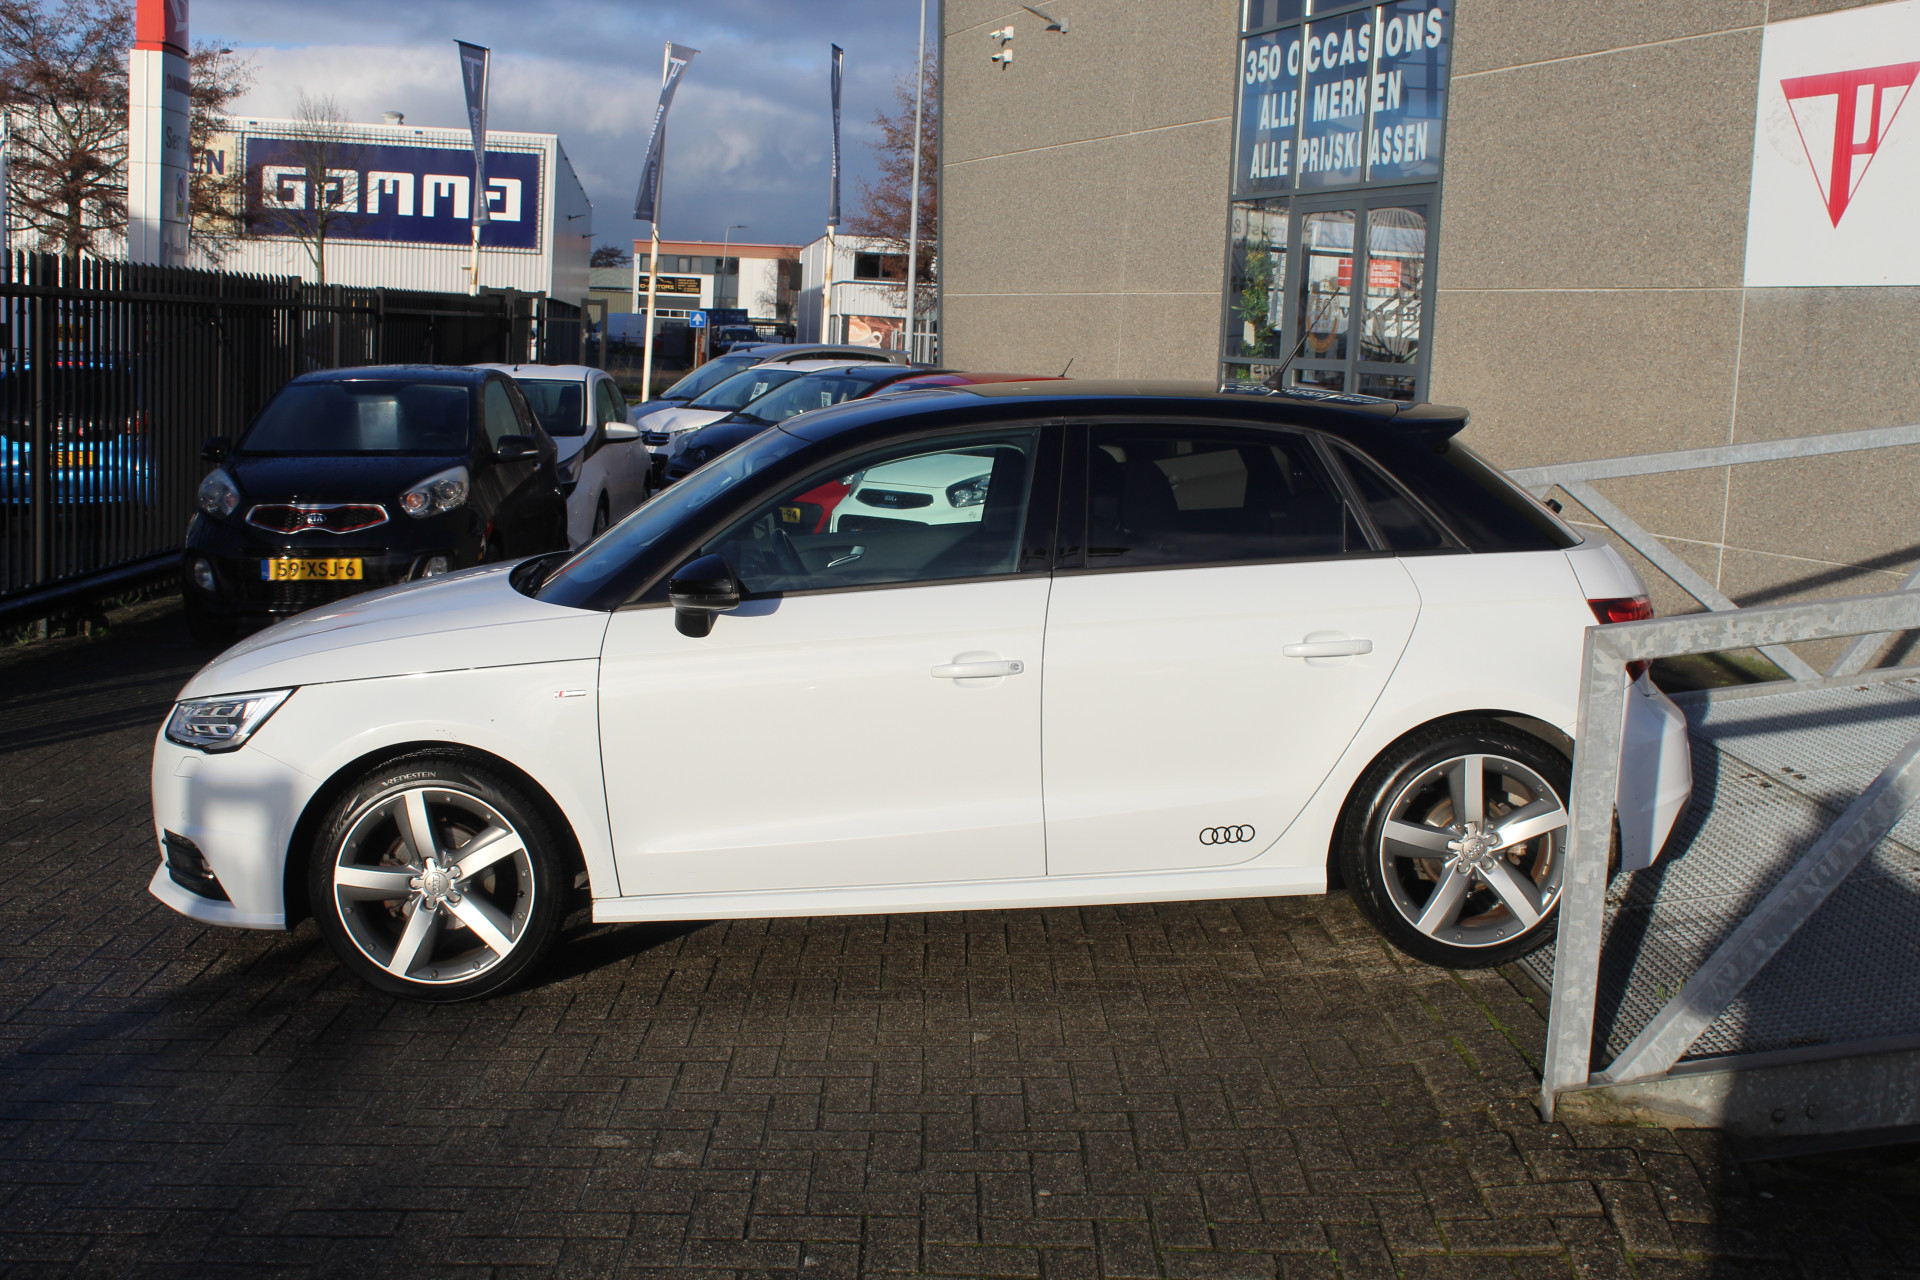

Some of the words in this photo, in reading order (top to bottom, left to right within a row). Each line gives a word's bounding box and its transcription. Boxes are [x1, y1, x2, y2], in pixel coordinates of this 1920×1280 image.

[1246, 44, 1281, 85] 350
[1287, 7, 1442, 78] OCCASIONS
[1259, 89, 1298, 131] ALLE
[1313, 69, 1402, 123] MERKEN
[1249, 139, 1290, 180] ALLE
[307, 515, 325, 523] KIA
[277, 561, 356, 577] 59-XSJ-6
[381, 771, 437, 786] VREDESTEIN
